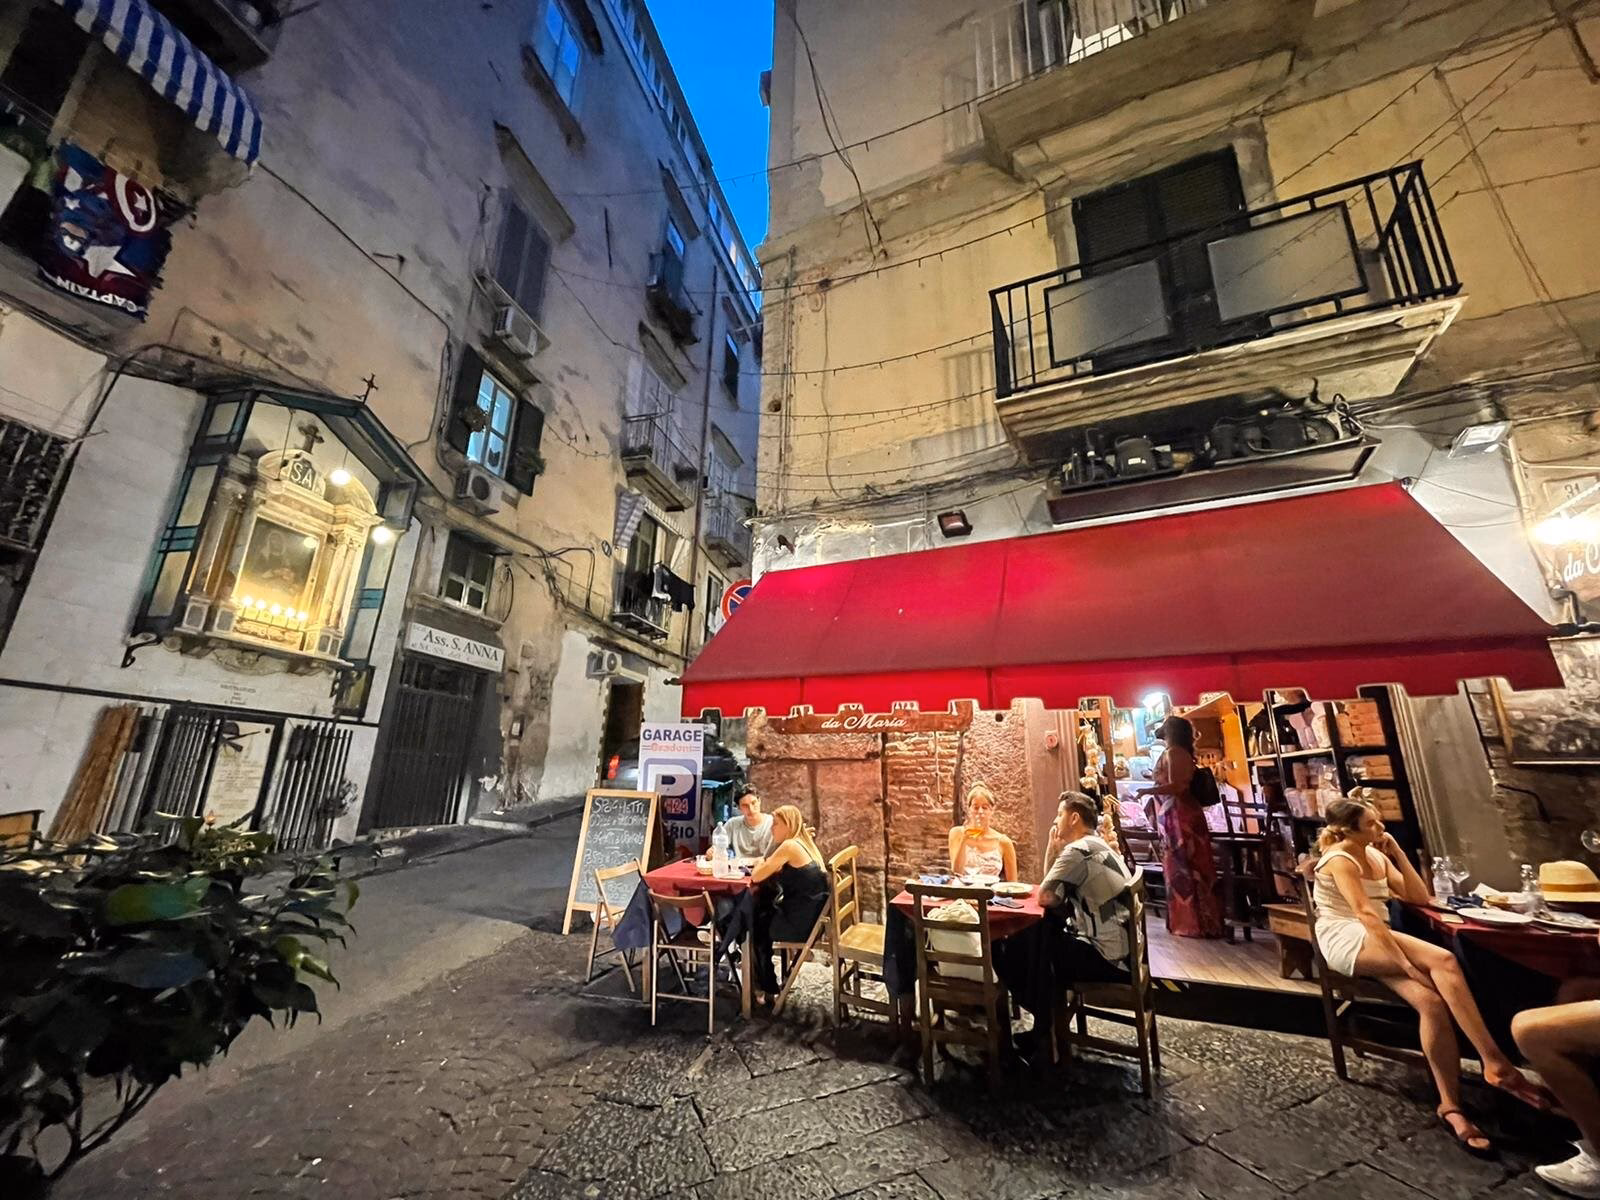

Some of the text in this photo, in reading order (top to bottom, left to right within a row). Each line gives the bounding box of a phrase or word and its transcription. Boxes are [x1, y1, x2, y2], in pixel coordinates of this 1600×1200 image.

[56, 276, 137, 312] CAPTAIN
[423, 629, 449, 648] Ass.
[451, 637, 461, 651] S.
[463, 642, 499, 661] ANNA
[821, 714, 907, 730] da Maria
[643, 728, 702, 742] GARAGE
